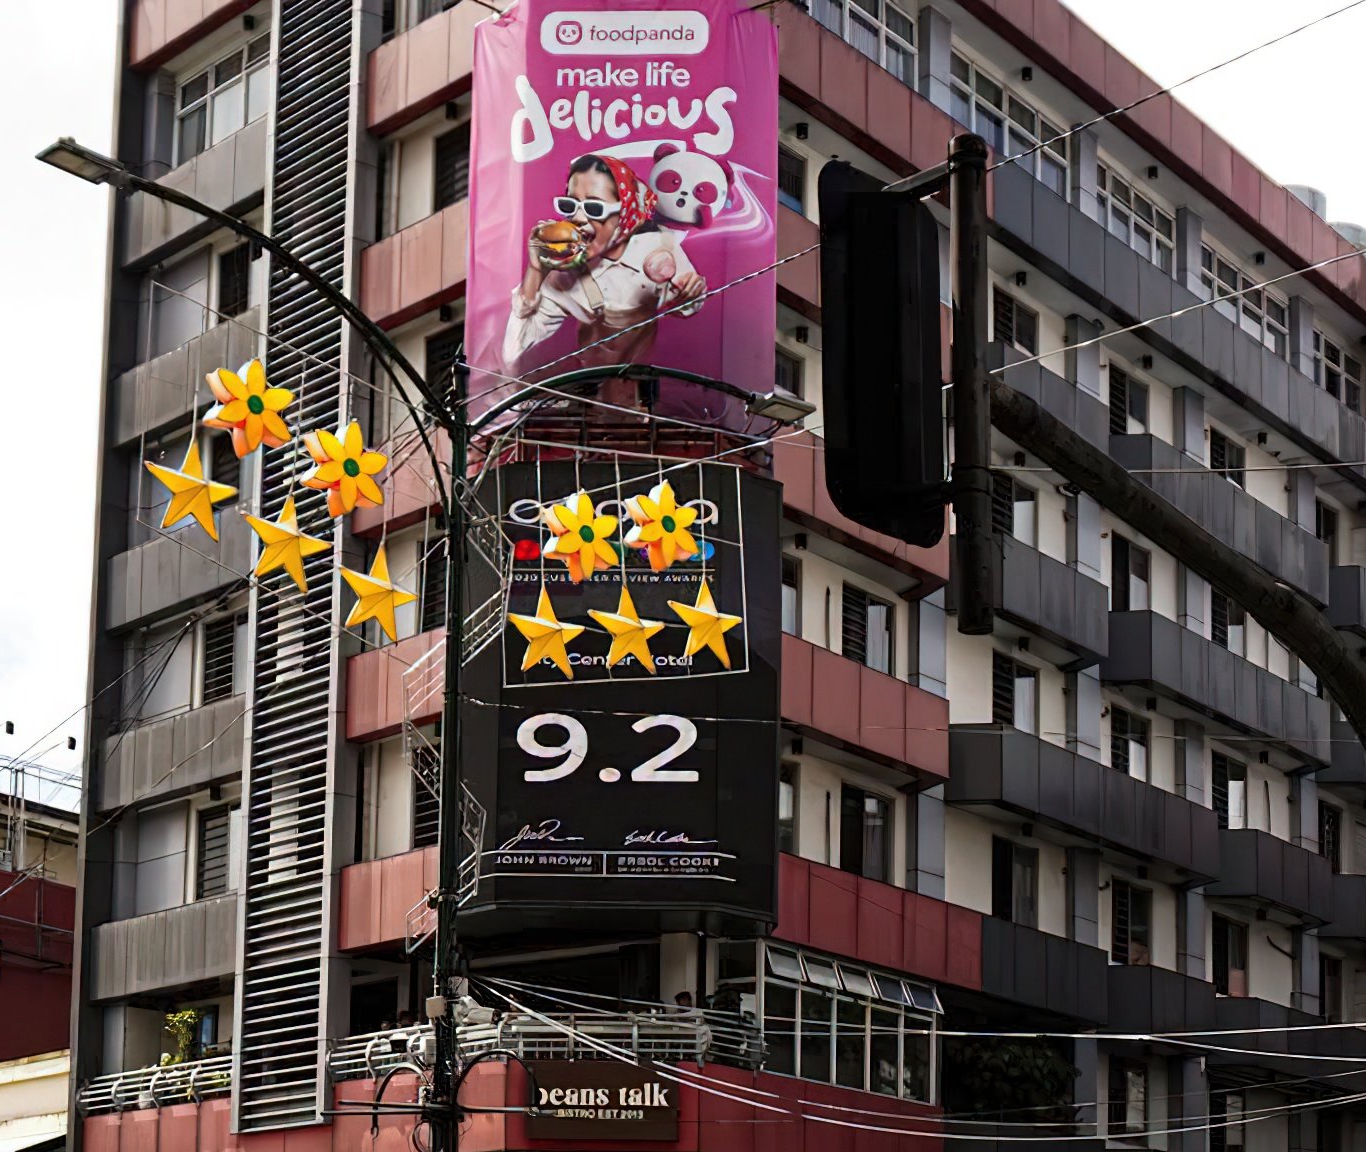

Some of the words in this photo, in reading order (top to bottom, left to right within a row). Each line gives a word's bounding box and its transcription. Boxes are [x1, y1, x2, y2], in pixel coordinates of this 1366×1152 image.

[589, 24, 695, 45] foodpanda
[556, 63, 638, 87] make
[645, 61, 690, 87] life
[510, 74, 737, 163] delicious
[516, 712, 700, 784] 9.2
[619, 1083, 669, 1106] talk
